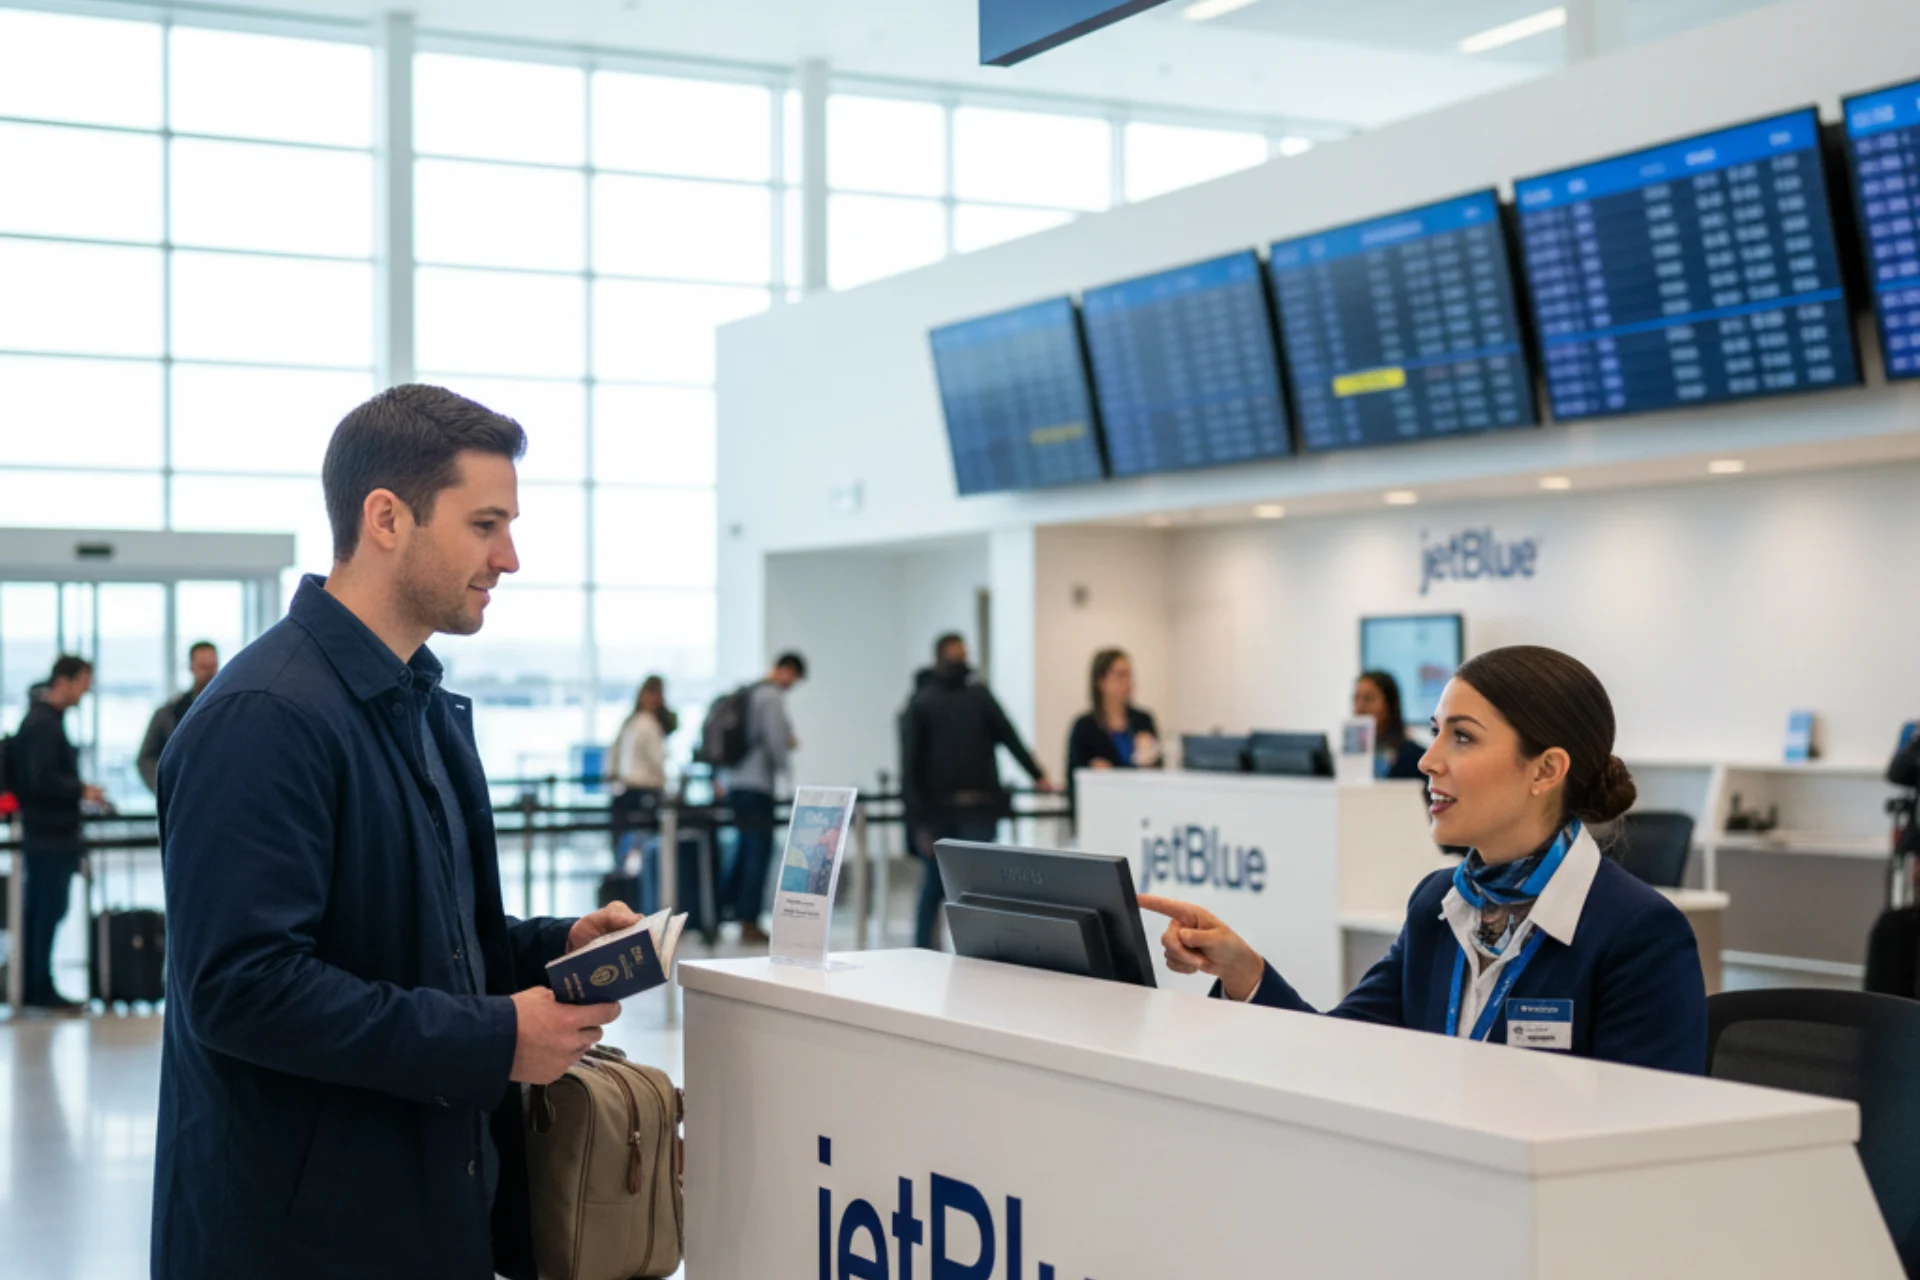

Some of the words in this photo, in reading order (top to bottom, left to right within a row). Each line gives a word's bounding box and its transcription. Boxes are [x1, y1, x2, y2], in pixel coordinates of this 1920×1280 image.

[1419, 528, 1537, 597] jetBlue
[1139, 817, 1268, 895] jetBlue
[817, 1134, 1096, 1280] jetB
